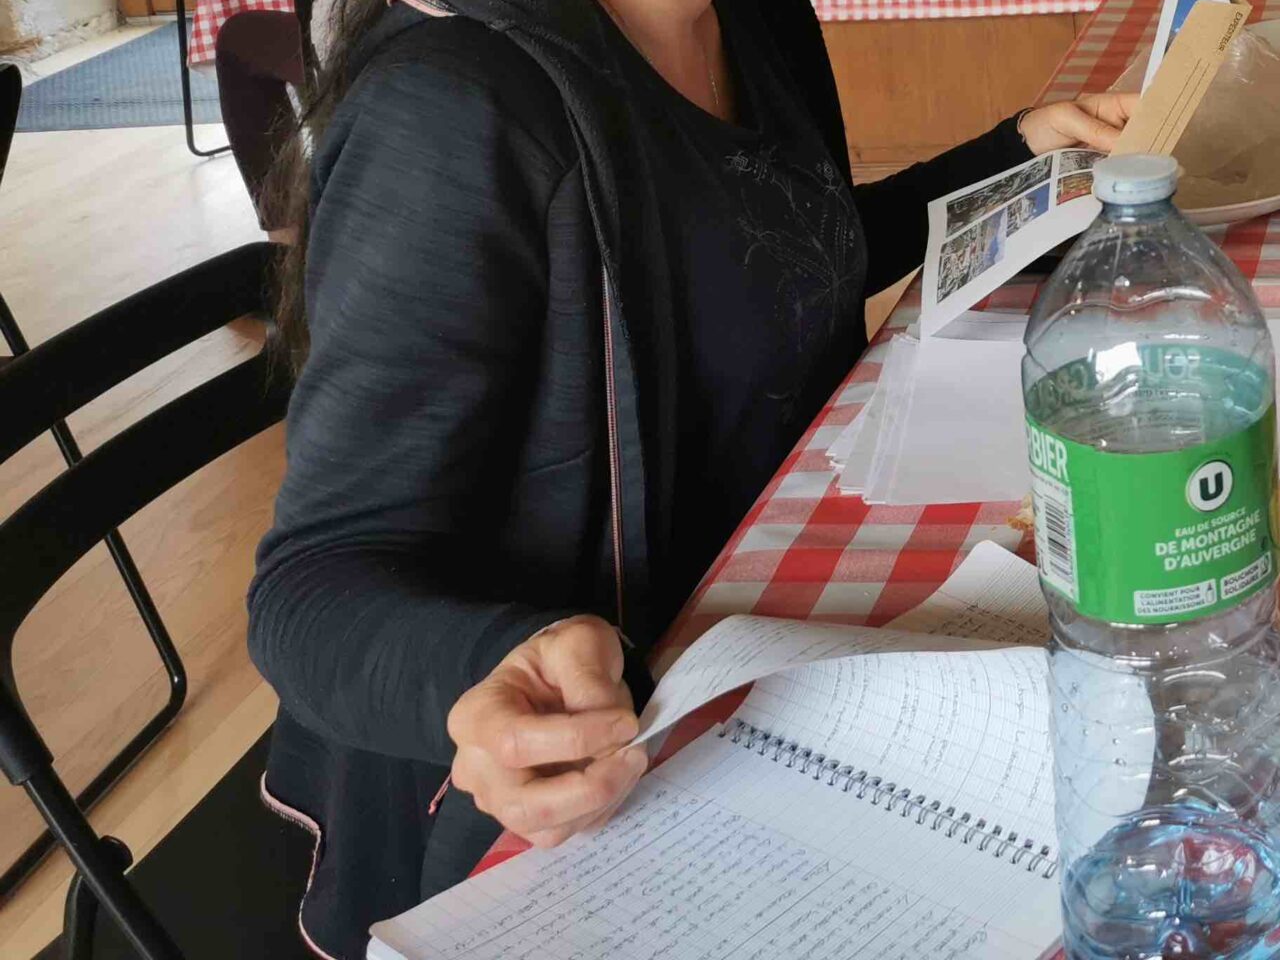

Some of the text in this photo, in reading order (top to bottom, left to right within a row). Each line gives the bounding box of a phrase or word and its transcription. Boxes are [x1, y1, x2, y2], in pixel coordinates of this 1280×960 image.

[1199, 471, 1224, 502] U
[1155, 509, 1261, 556] DE MONTAGNE
[1175, 506, 1246, 538] EAU DE SOURCE
[1164, 528, 1257, 572] D'AUVERGNE
[1223, 563, 1259, 587] BOUCHON
